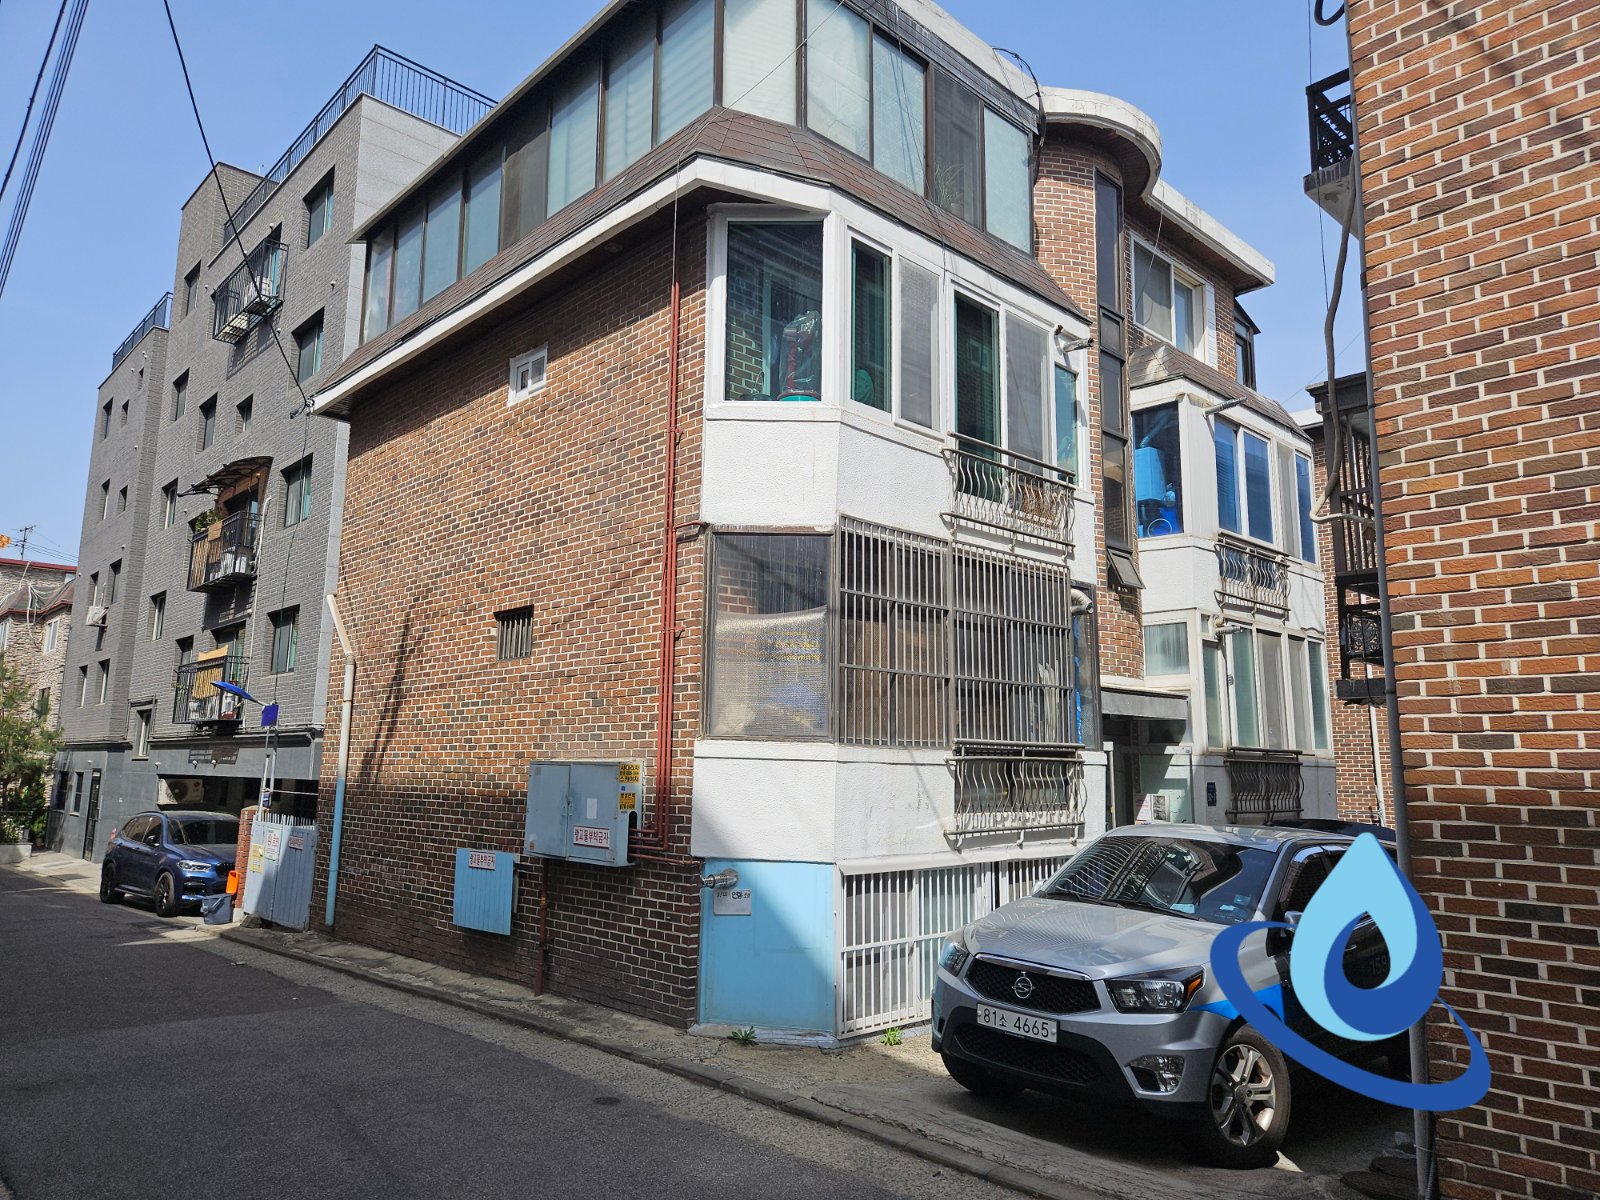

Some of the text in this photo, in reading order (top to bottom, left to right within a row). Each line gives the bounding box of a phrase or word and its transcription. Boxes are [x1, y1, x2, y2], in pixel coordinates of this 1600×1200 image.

[574, 829, 609, 844] 광고물부착금지
[983, 1007, 1049, 1038] 81소 4665
